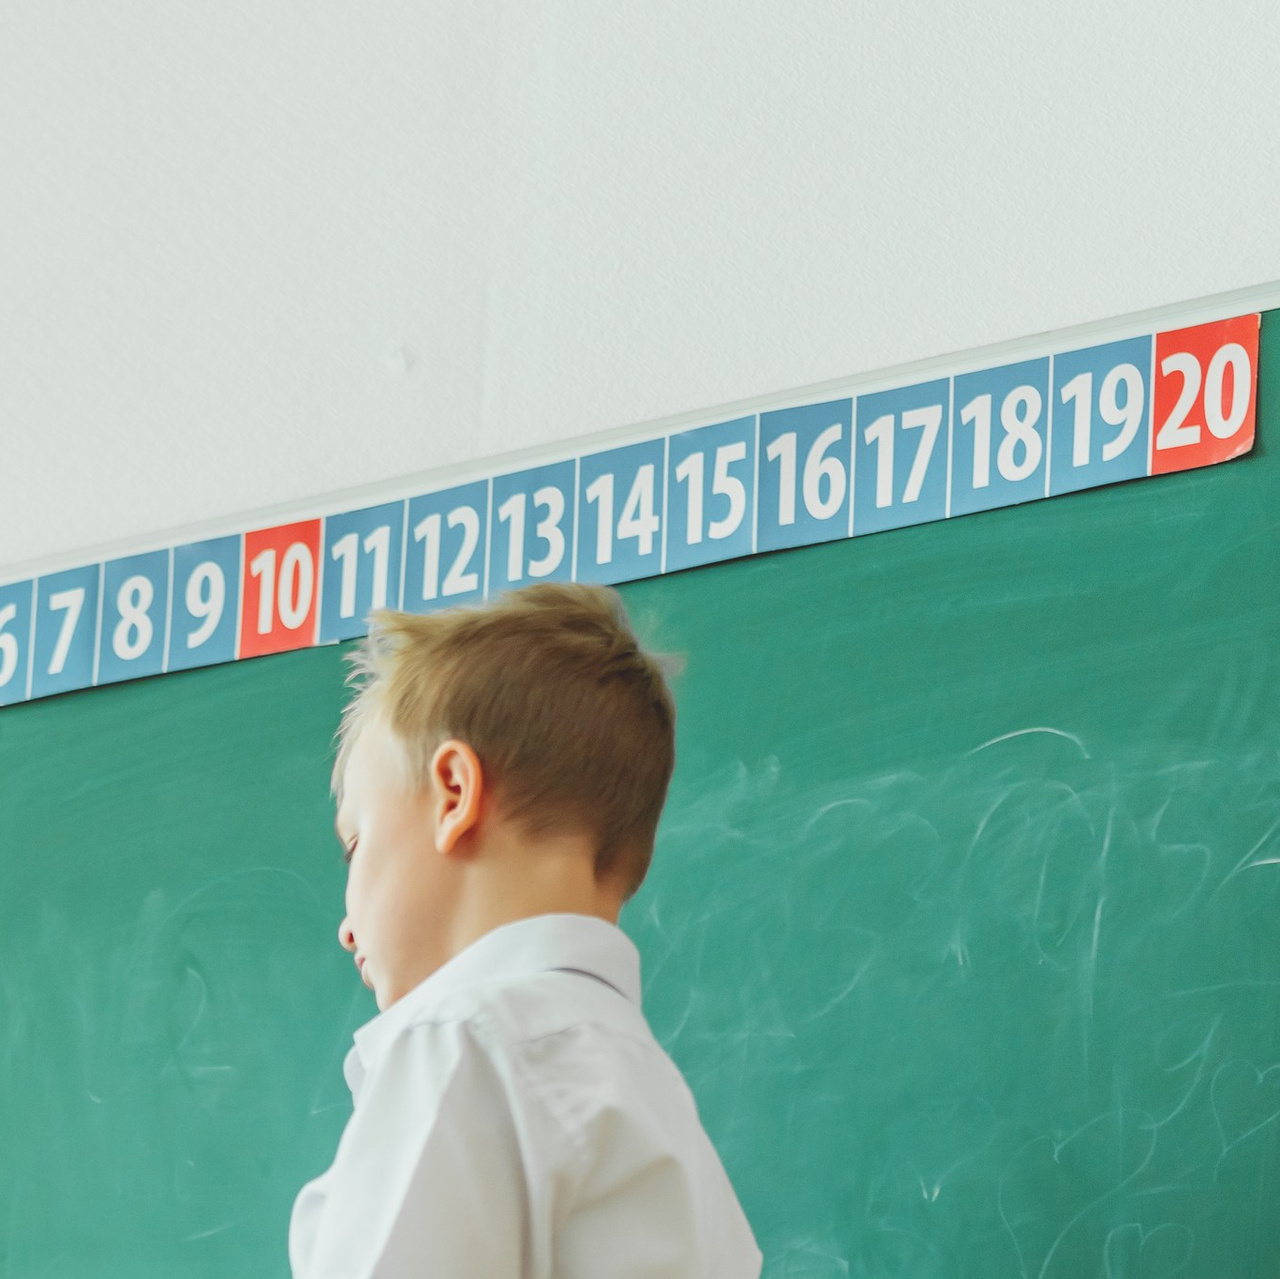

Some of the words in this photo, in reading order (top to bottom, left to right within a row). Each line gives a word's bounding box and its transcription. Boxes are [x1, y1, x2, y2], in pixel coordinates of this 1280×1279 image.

[47, 587, 86, 675] 7
[112, 574, 154, 661] 8
[185, 560, 226, 649] 9
[248, 541, 315, 635] 10
[331, 524, 393, 620] 11
[413, 505, 480, 601] 12
[498, 485, 566, 582] 13
[585, 463, 660, 565] 14
[675, 441, 747, 545] 15
[766, 423, 847, 526] 16
[863, 404, 943, 509] 17
[960, 384, 1043, 490] 18
[1060, 362, 1145, 468] 19
[1155, 342, 1251, 451] 20
